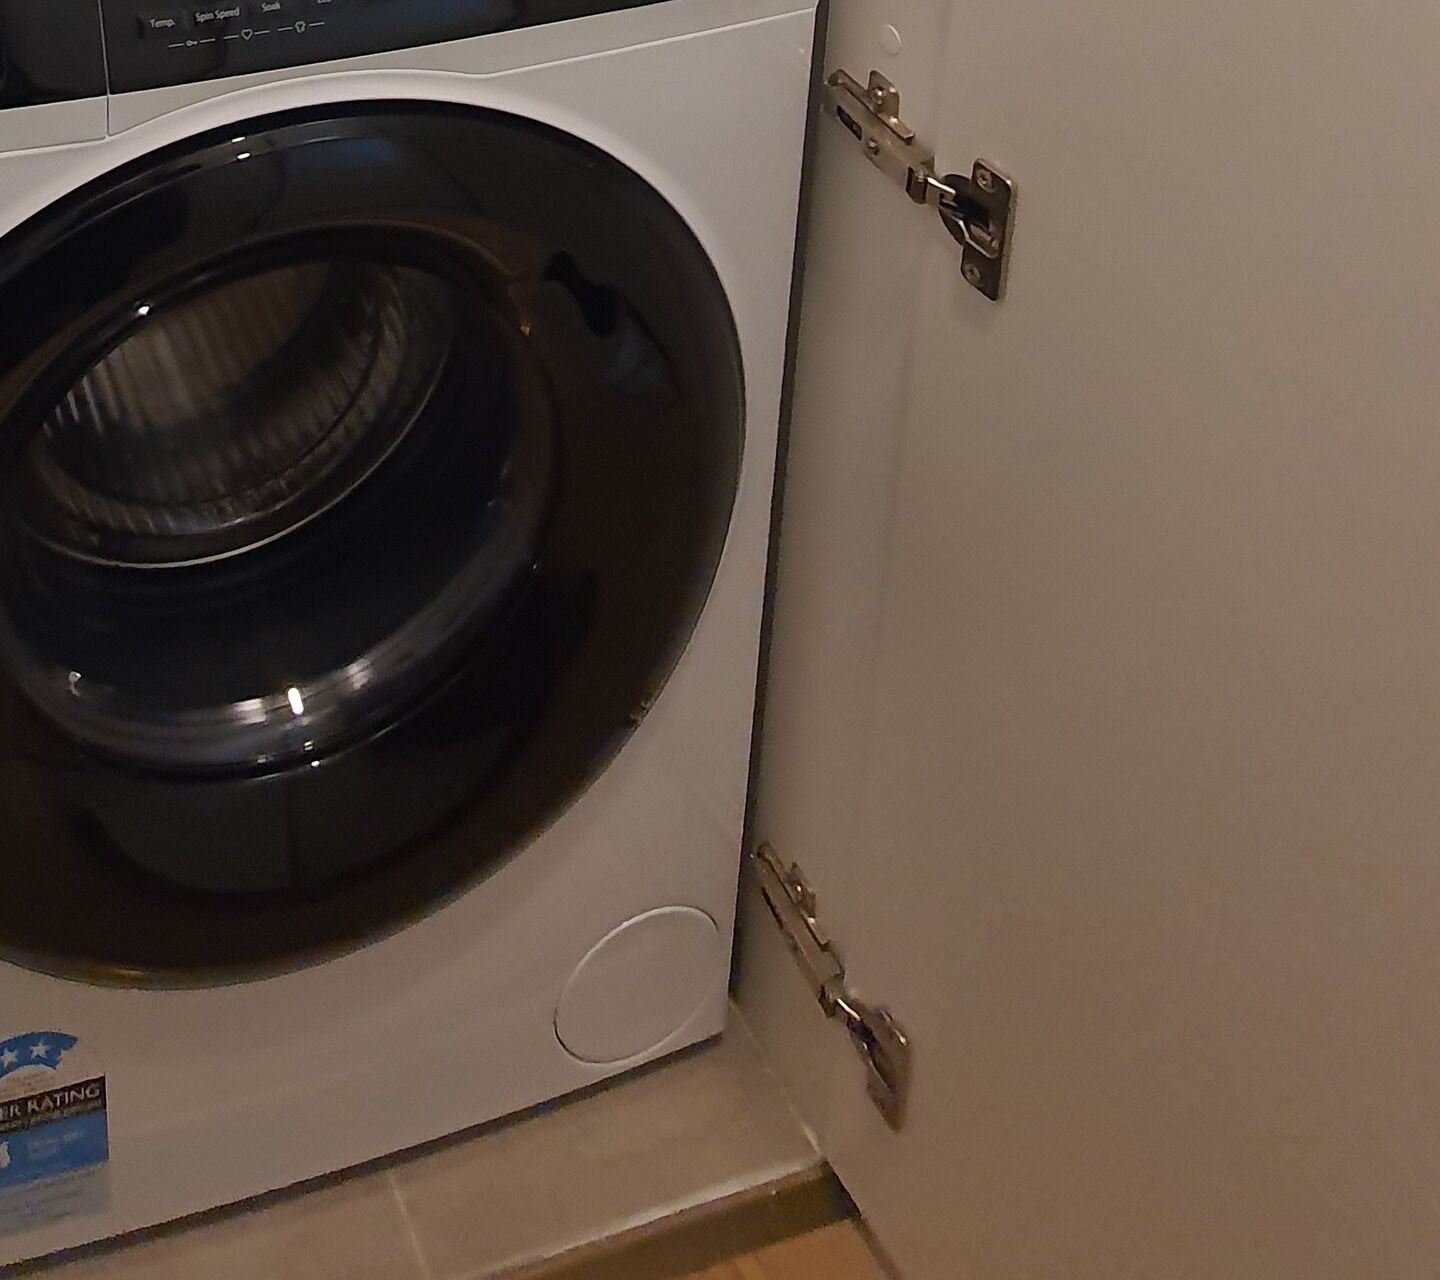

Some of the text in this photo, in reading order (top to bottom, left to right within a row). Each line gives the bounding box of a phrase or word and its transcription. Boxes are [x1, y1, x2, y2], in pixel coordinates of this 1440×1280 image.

[195, 6, 240, 23] Spin Speed
[261, 1, 280, 13] Soak
[27, 1082, 101, 1113] RATING
